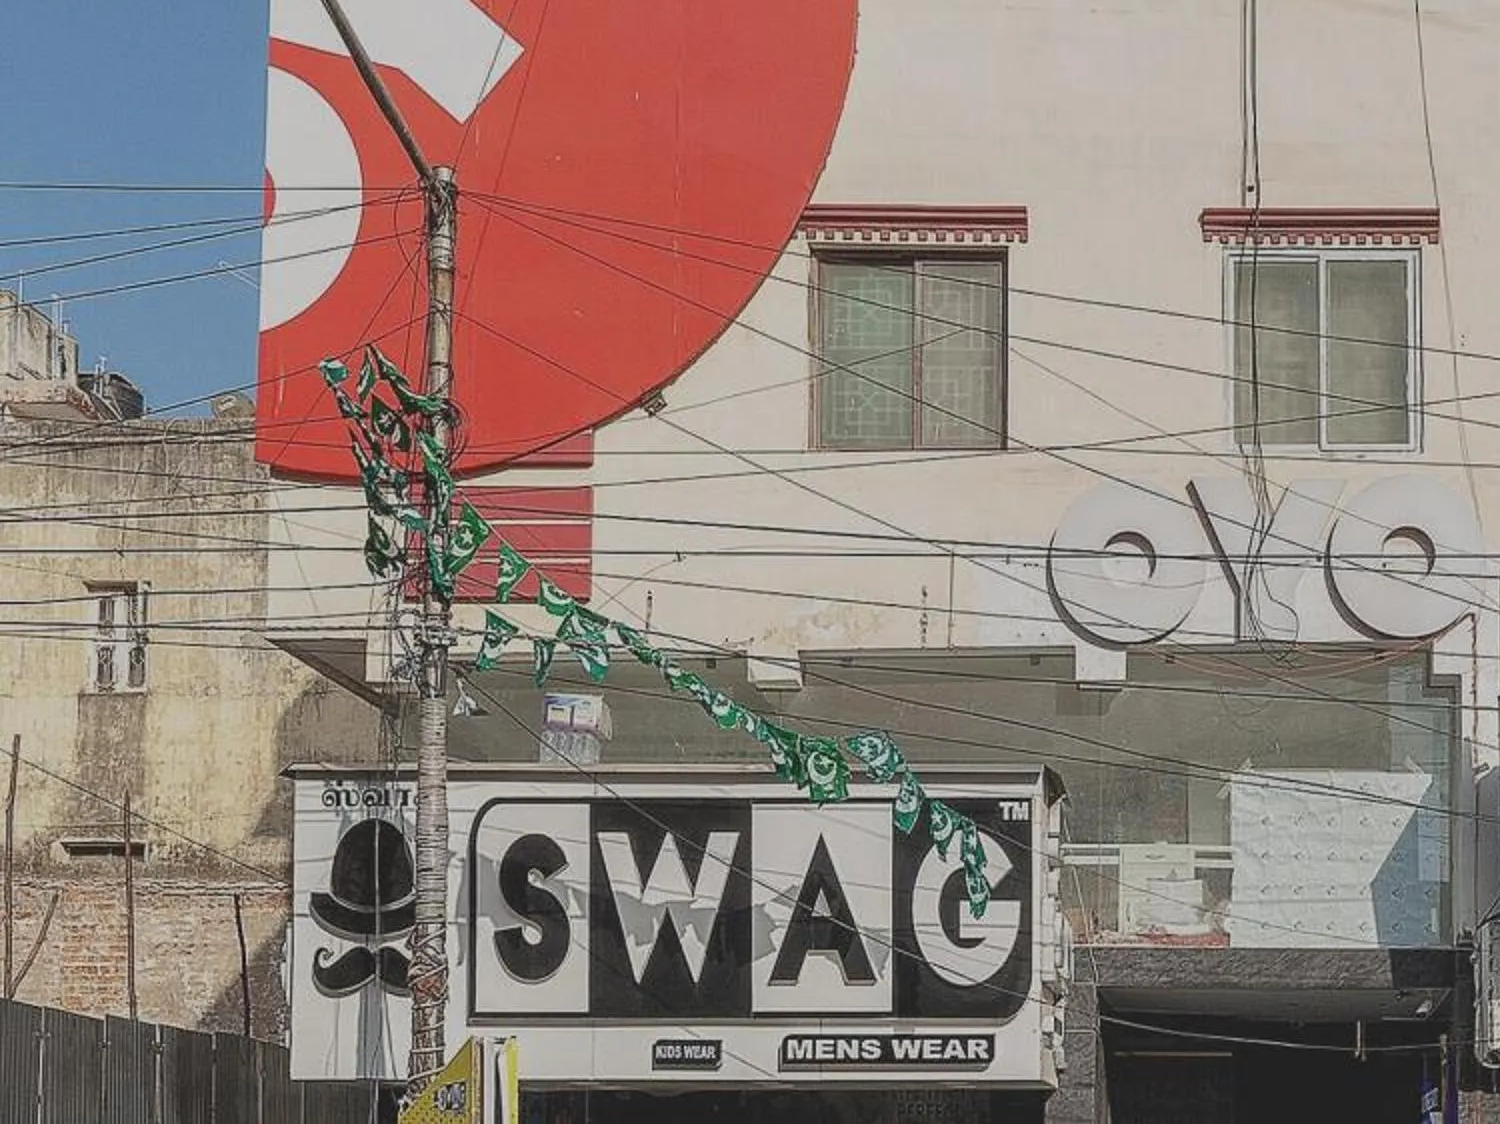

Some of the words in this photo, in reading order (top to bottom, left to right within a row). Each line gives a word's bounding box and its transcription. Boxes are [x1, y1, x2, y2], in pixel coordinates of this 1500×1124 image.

[491, 829, 1024, 988] SWAG
[998, 801, 1029, 821] TM
[655, 1044, 683, 1059] KIDS
[684, 1044, 717, 1059] WEAR
[786, 1038, 882, 1061] MENS
[891, 1038, 990, 1060] WEAR
